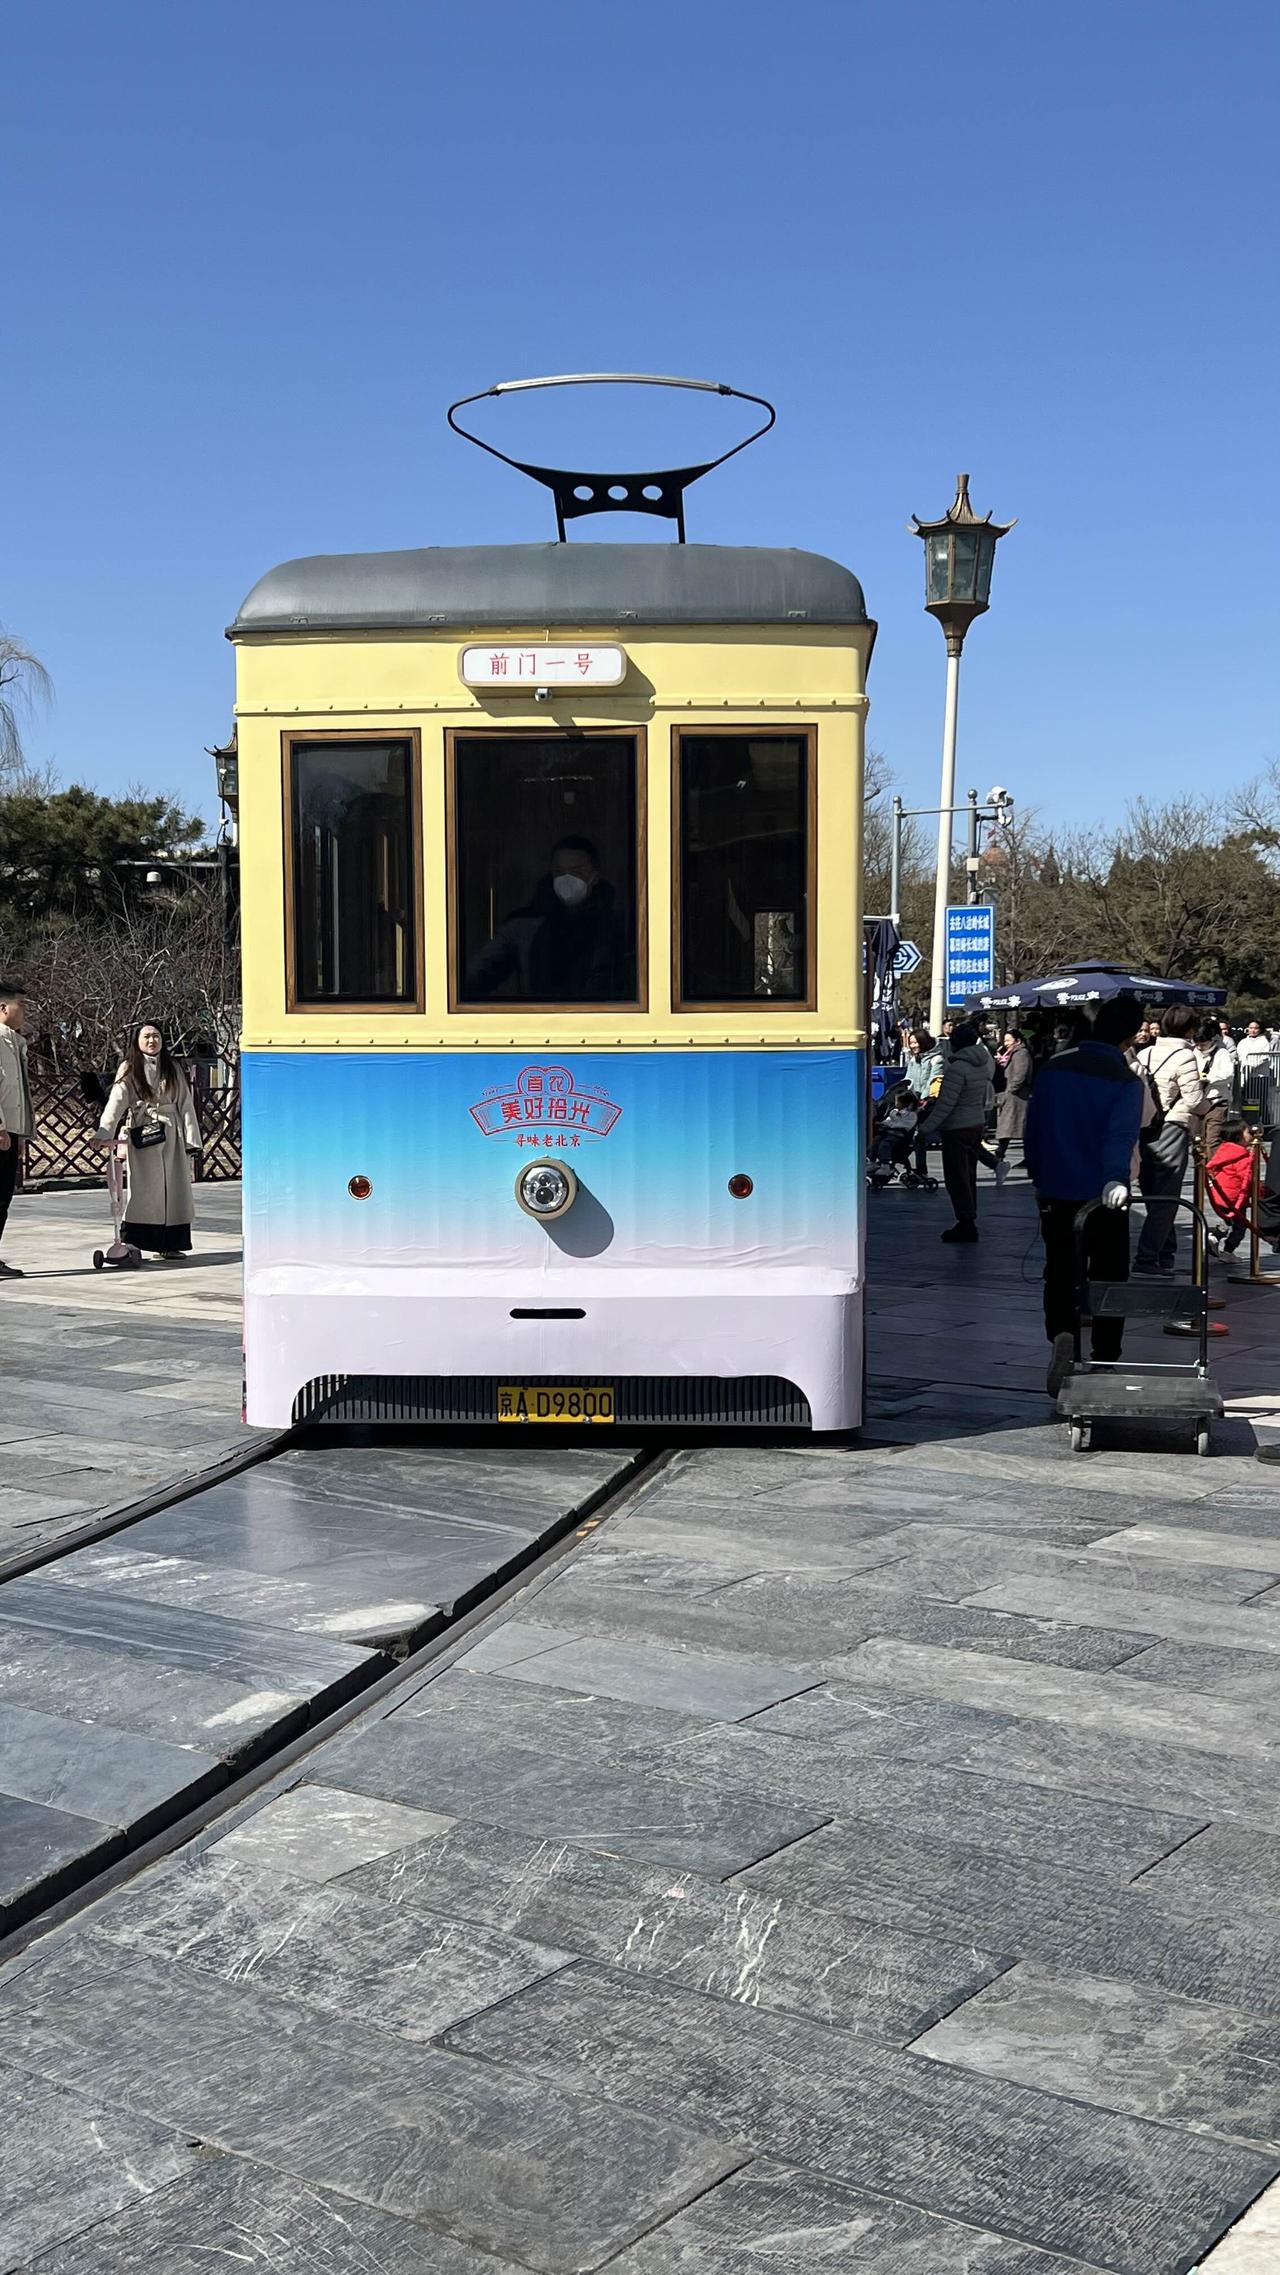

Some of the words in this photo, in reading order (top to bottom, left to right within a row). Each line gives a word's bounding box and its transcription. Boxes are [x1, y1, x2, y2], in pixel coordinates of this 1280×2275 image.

[489, 652, 593, 676] 前门一号
[527, 1075, 564, 1092] 首农
[501, 1097, 590, 1124] 美好拾光
[515, 1134, 581, 1148] 寻味老北京
